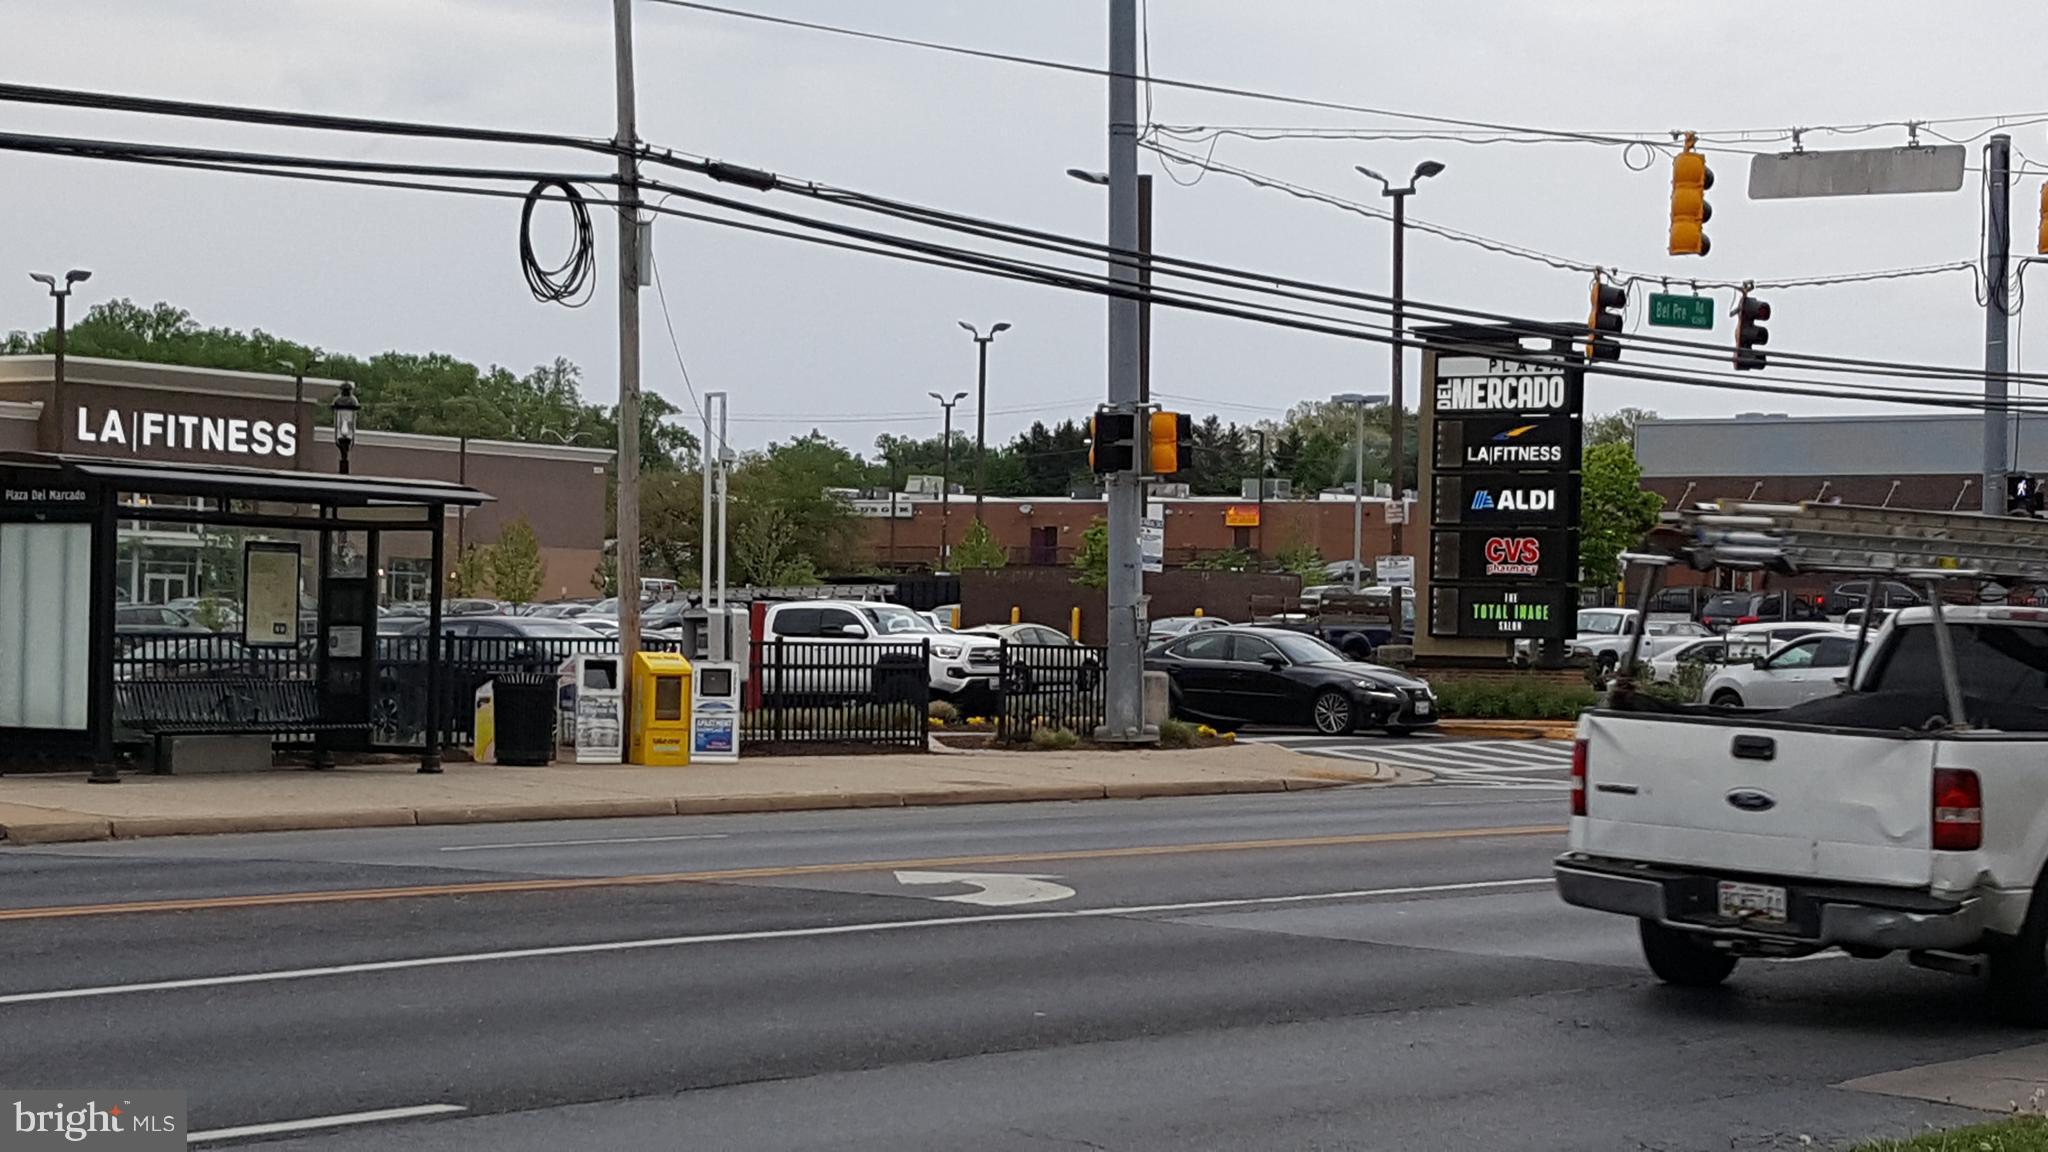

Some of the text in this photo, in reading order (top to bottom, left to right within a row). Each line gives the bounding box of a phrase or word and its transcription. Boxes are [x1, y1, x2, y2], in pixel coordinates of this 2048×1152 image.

[1656, 301, 1670, 319] Bel
[1672, 303, 1687, 320] Pre
[1436, 376, 1564, 410] DEL MERCADO
[142, 412, 297, 457] FITNESS
[1493, 446, 1562, 461] FITNESS
[5, 489, 28, 500] Plaza
[31, 489, 46, 500] Del
[1497, 490, 1555, 510] ALDI
[1485, 537, 1540, 564] CVS
[1486, 563, 1538, 575] pharmacy
[1473, 604, 1549, 621] TOTAL IMAGE
